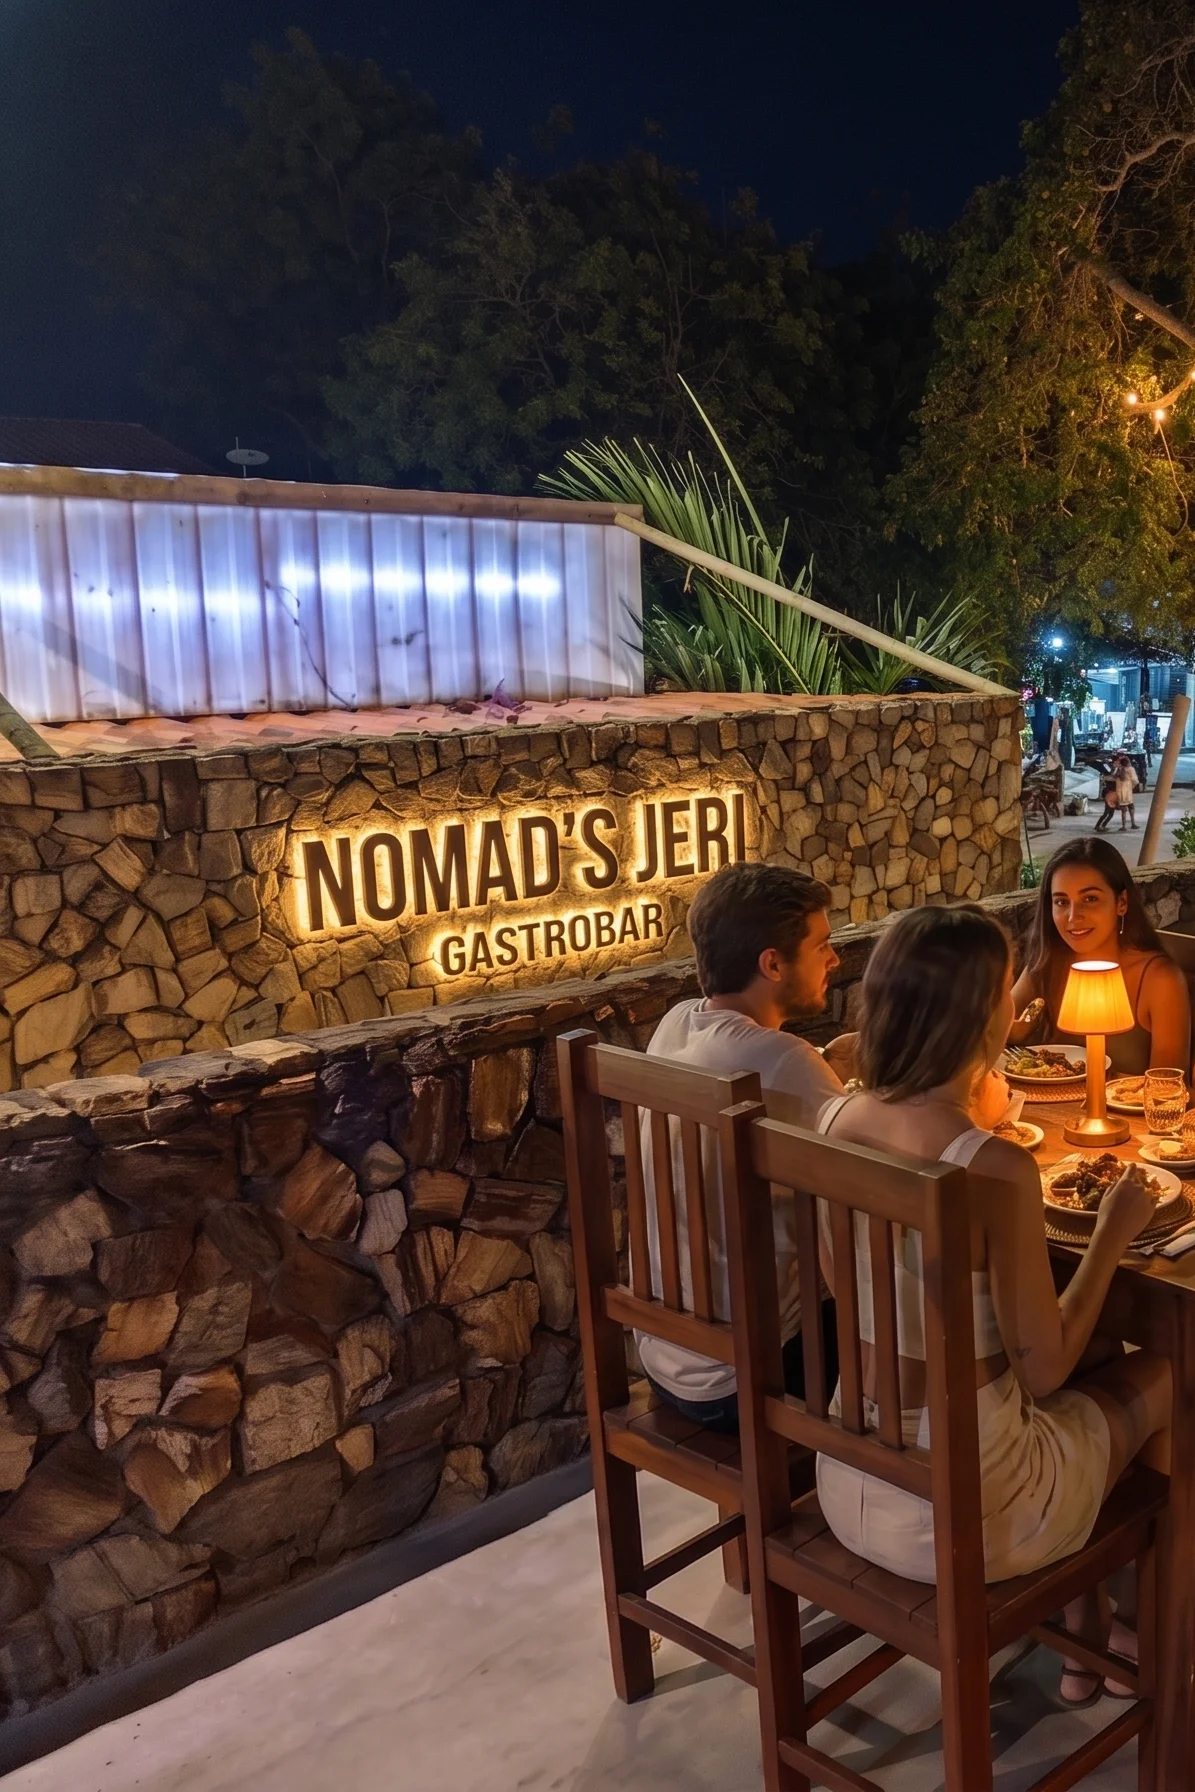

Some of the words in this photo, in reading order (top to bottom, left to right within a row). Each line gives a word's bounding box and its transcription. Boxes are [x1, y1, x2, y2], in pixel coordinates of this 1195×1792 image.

[302, 808, 619, 931] NOMAD'S
[636, 793, 746, 883] JERI
[440, 902, 664, 976] GASTROBAR
